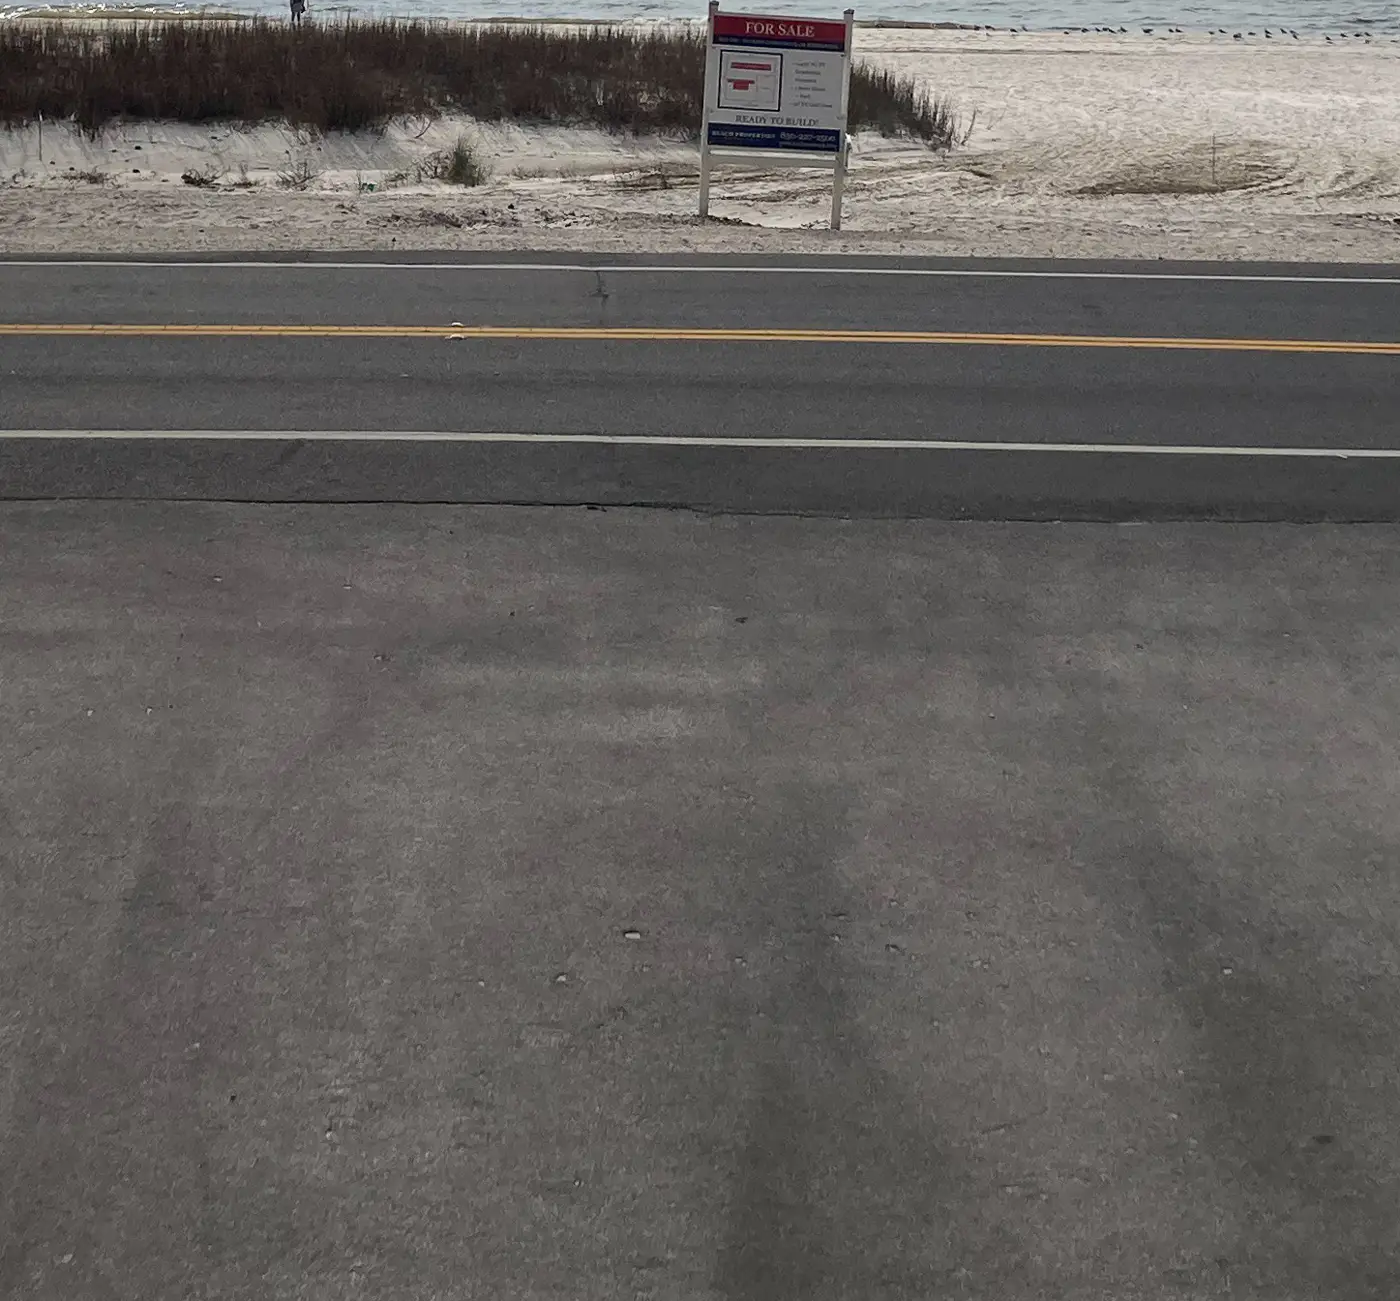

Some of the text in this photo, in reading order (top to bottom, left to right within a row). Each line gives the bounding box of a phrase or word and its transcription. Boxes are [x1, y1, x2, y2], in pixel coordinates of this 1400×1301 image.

[745, 21, 815, 37] FOR SALE
[735, 115, 767, 124] READY
[770, 116, 784, 125] TO
